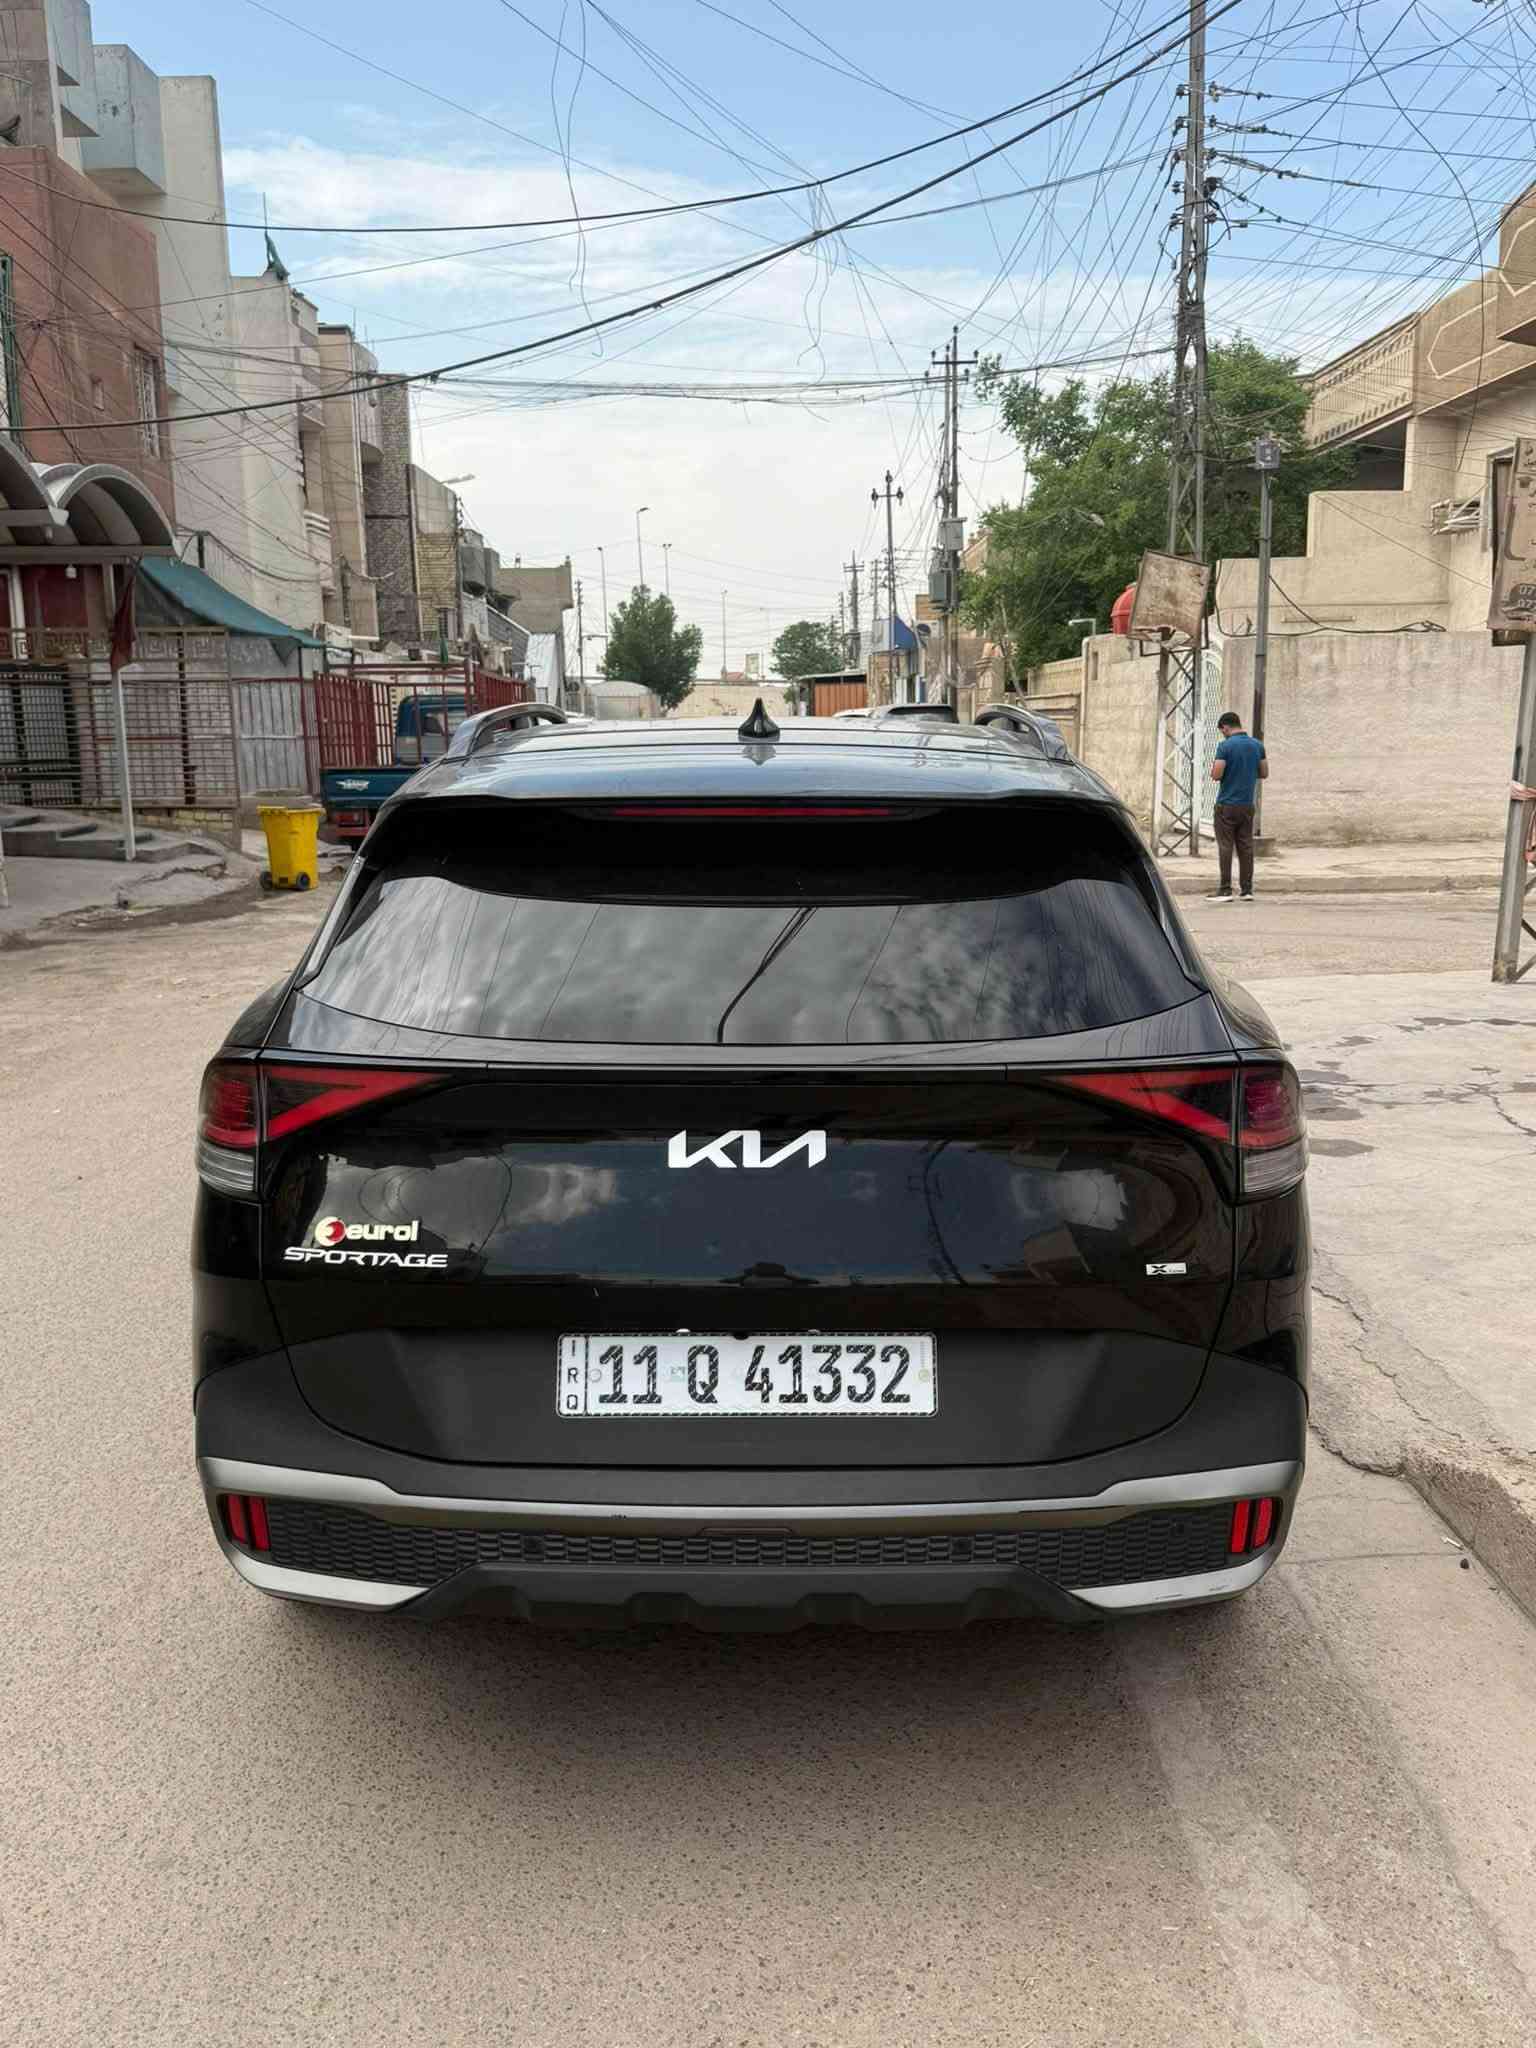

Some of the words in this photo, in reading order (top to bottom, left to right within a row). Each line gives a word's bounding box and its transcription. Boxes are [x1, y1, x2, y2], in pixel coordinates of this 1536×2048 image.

[668, 1130, 826, 1168] KIA
[346, 1220, 419, 1241] eurol
[283, 1247, 448, 1268] SPORTAGE
[599, 1345, 662, 1404] 11
[687, 1345, 719, 1404] Q
[745, 1345, 911, 1404] 41332
